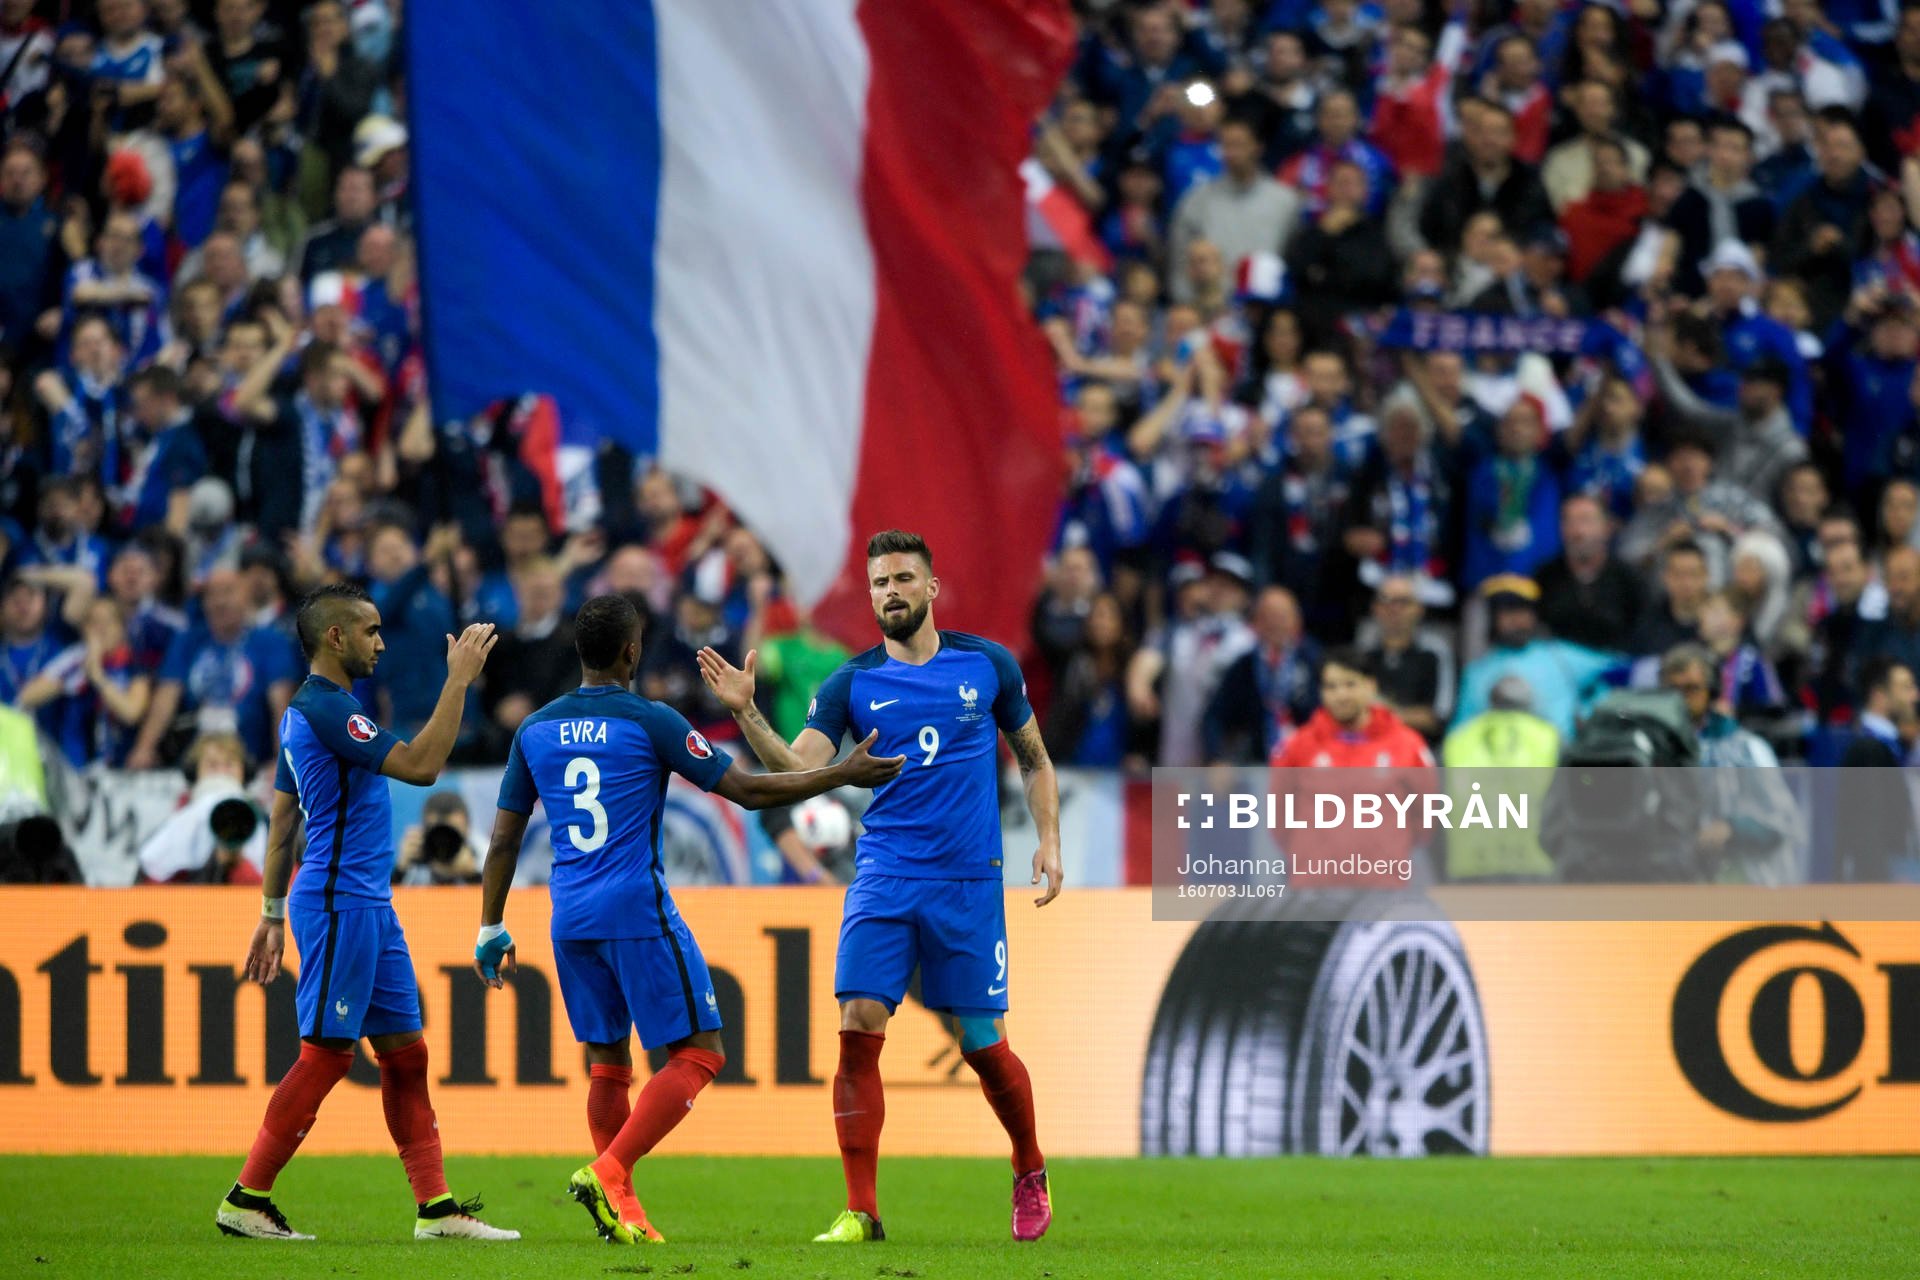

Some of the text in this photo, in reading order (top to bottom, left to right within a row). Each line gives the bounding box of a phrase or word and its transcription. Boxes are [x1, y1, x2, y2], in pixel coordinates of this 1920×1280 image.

[560, 720, 607, 745] EVRA
[918, 725, 940, 766] 9
[564, 757, 608, 853] 3
[995, 940, 1006, 981] 9
